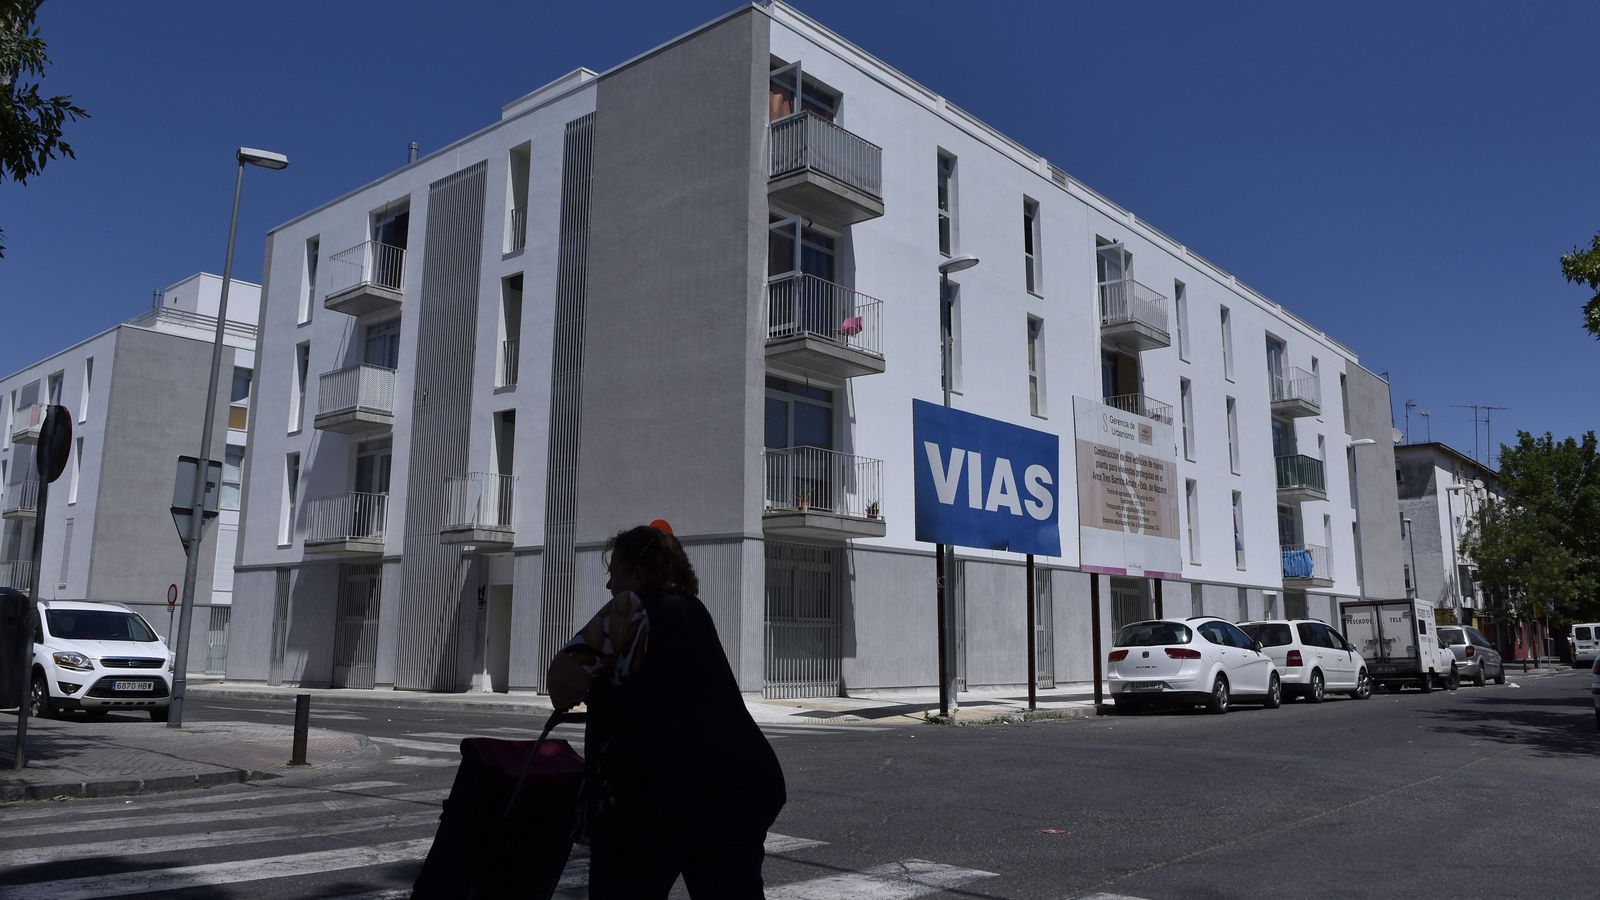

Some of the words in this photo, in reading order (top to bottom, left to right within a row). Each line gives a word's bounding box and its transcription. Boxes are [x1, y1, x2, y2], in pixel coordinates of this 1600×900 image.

[1110, 416, 1129, 428] Gerencia
[1129, 422, 1136, 430] de
[1111, 427, 1135, 440] Urbanismo
[924, 441, 1053, 521] VIAS
